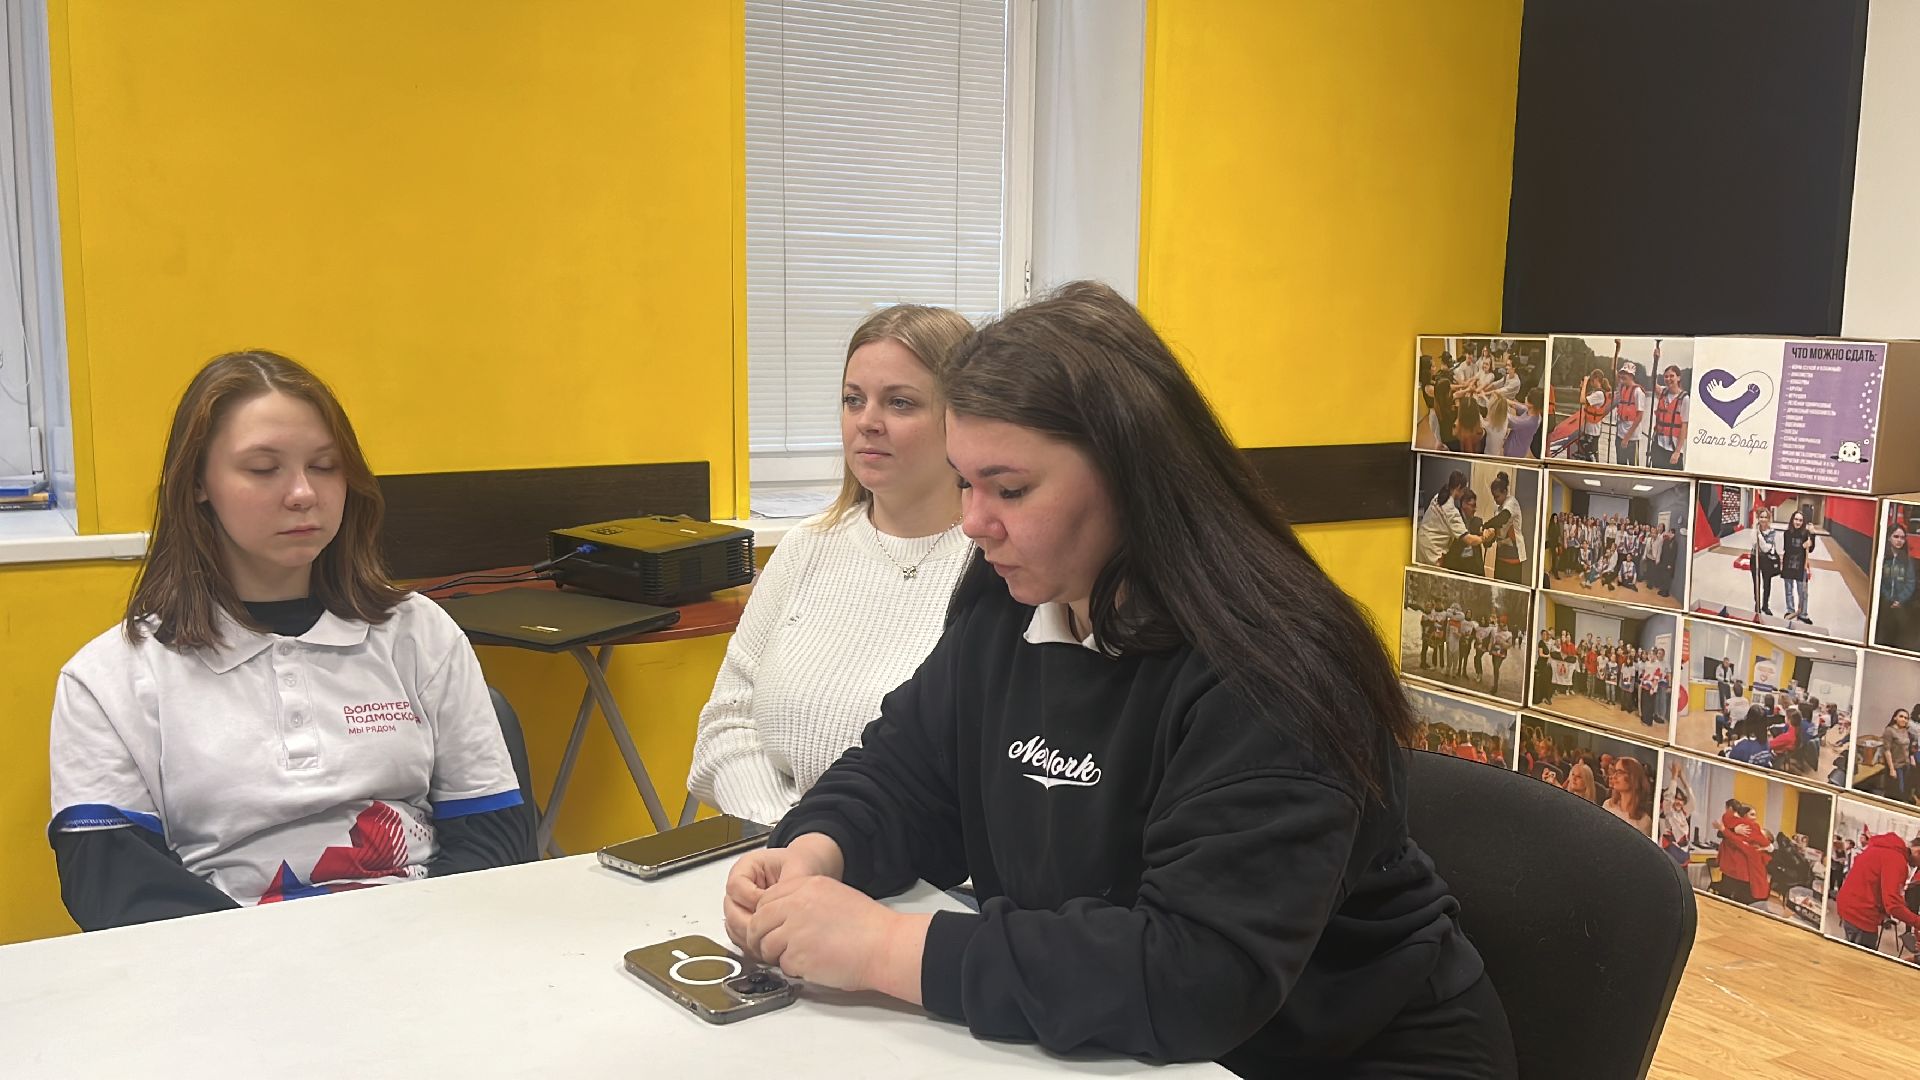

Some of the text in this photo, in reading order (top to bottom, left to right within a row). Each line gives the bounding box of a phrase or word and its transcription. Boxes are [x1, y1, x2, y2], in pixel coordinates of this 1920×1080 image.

[1792, 347, 1877, 362] ЧТО МОЖНО СДАТЬ:
[1728, 433, 1768, 455] Добра
[343, 701, 410, 715] ВОЛОНТЕР
[348, 725, 397, 735] МЫ РЯДОМ
